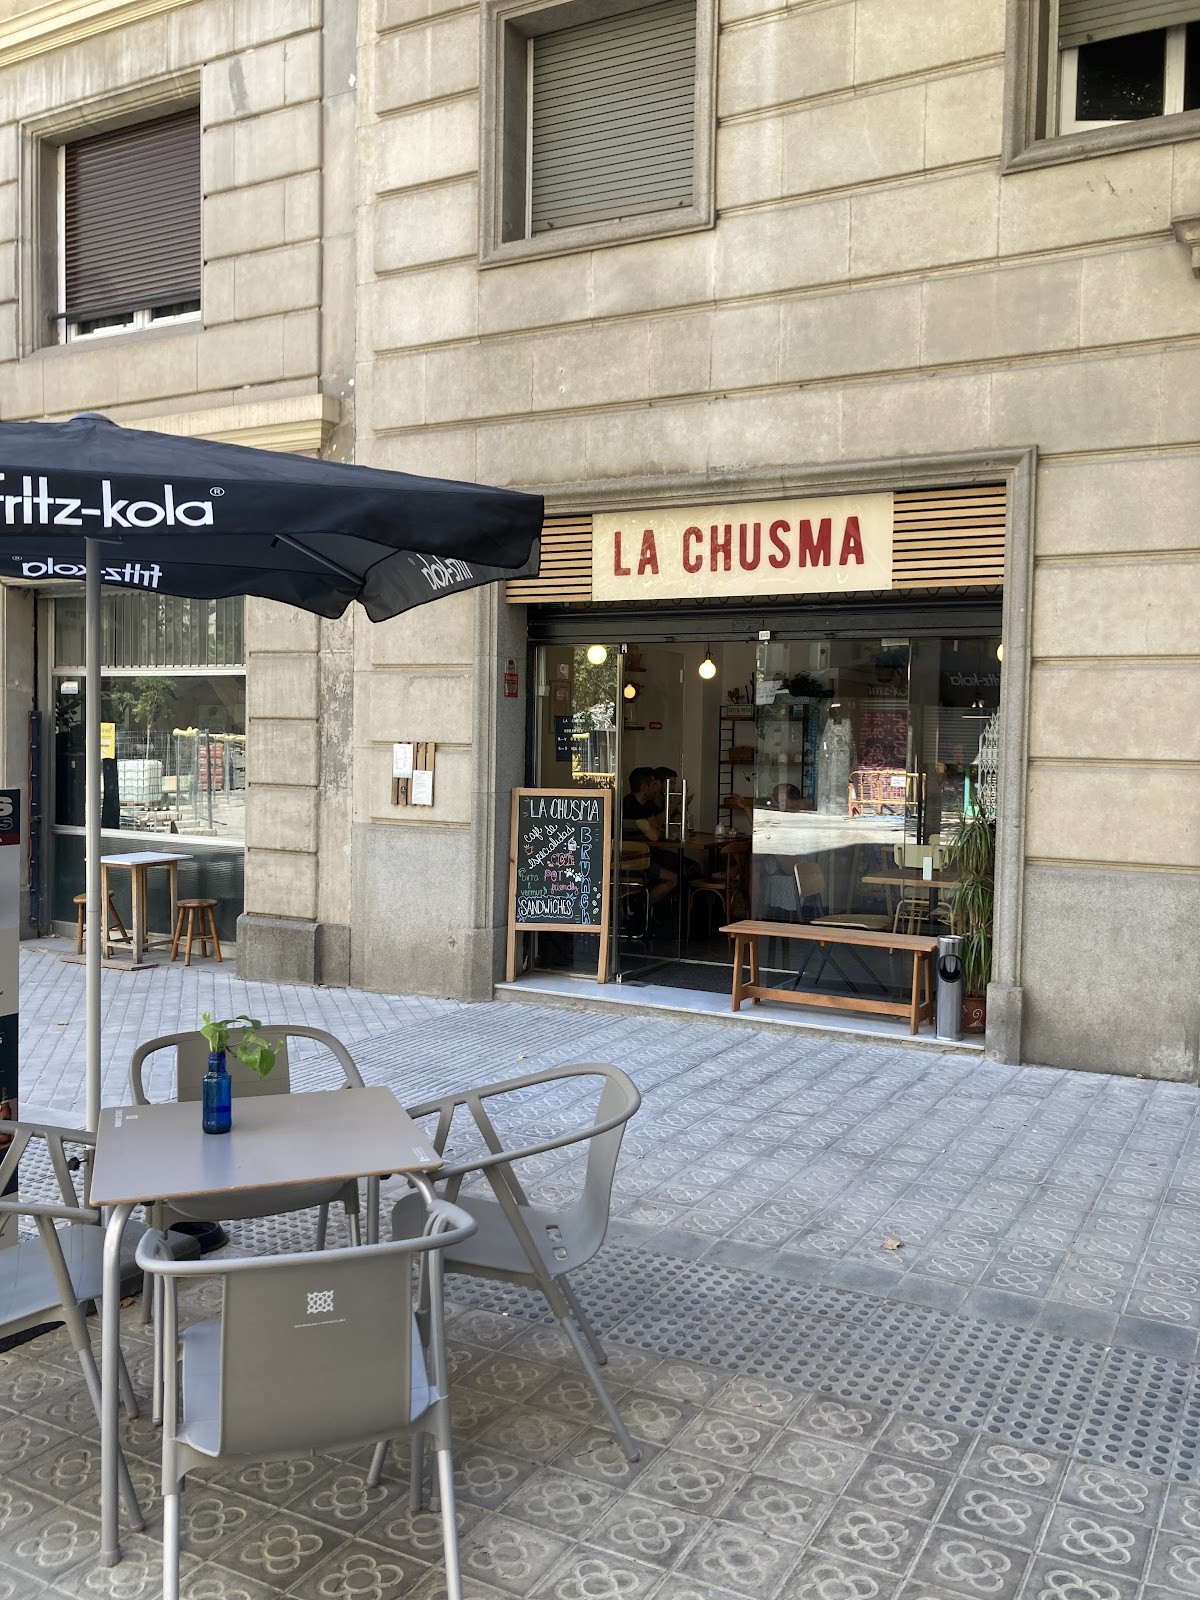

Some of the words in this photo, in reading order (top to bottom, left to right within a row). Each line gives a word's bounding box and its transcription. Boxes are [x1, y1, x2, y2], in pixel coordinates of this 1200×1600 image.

[614, 529, 659, 576] LA
[682, 516, 865, 573] CHUSMA
[530, 798, 548, 818] LA
[549, 798, 600, 821] CHUSMA
[528, 824, 576, 869] especialidad
[544, 824, 558, 836] de
